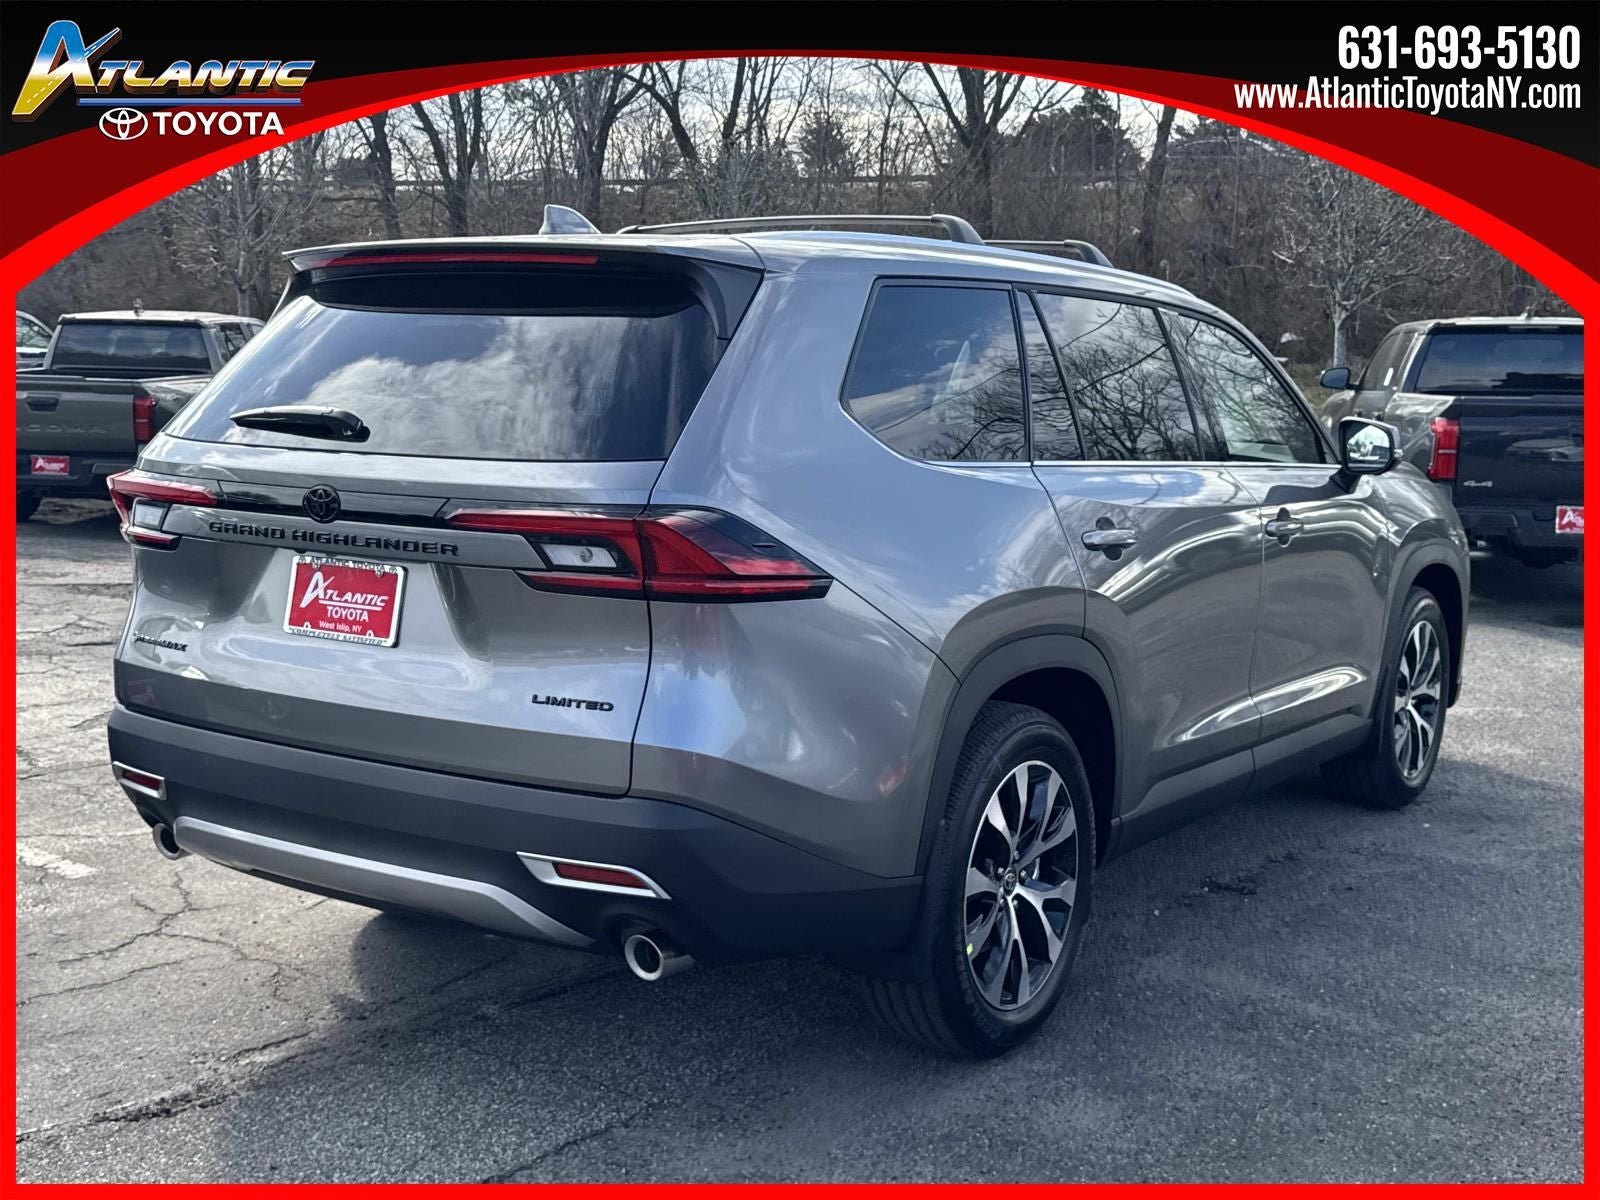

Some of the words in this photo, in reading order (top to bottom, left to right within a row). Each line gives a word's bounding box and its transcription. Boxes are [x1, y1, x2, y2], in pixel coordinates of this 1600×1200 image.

[208, 521, 286, 540] GRAND
[292, 529, 459, 557] HIGHLANDER
[300, 571, 389, 608] ATLANTIC
[326, 606, 369, 622] TOYOTA
[319, 620, 336, 630] West
[336, 621, 351, 633] Islip,
[352, 624, 363, 633] NY
[531, 694, 614, 712] LIMITED
